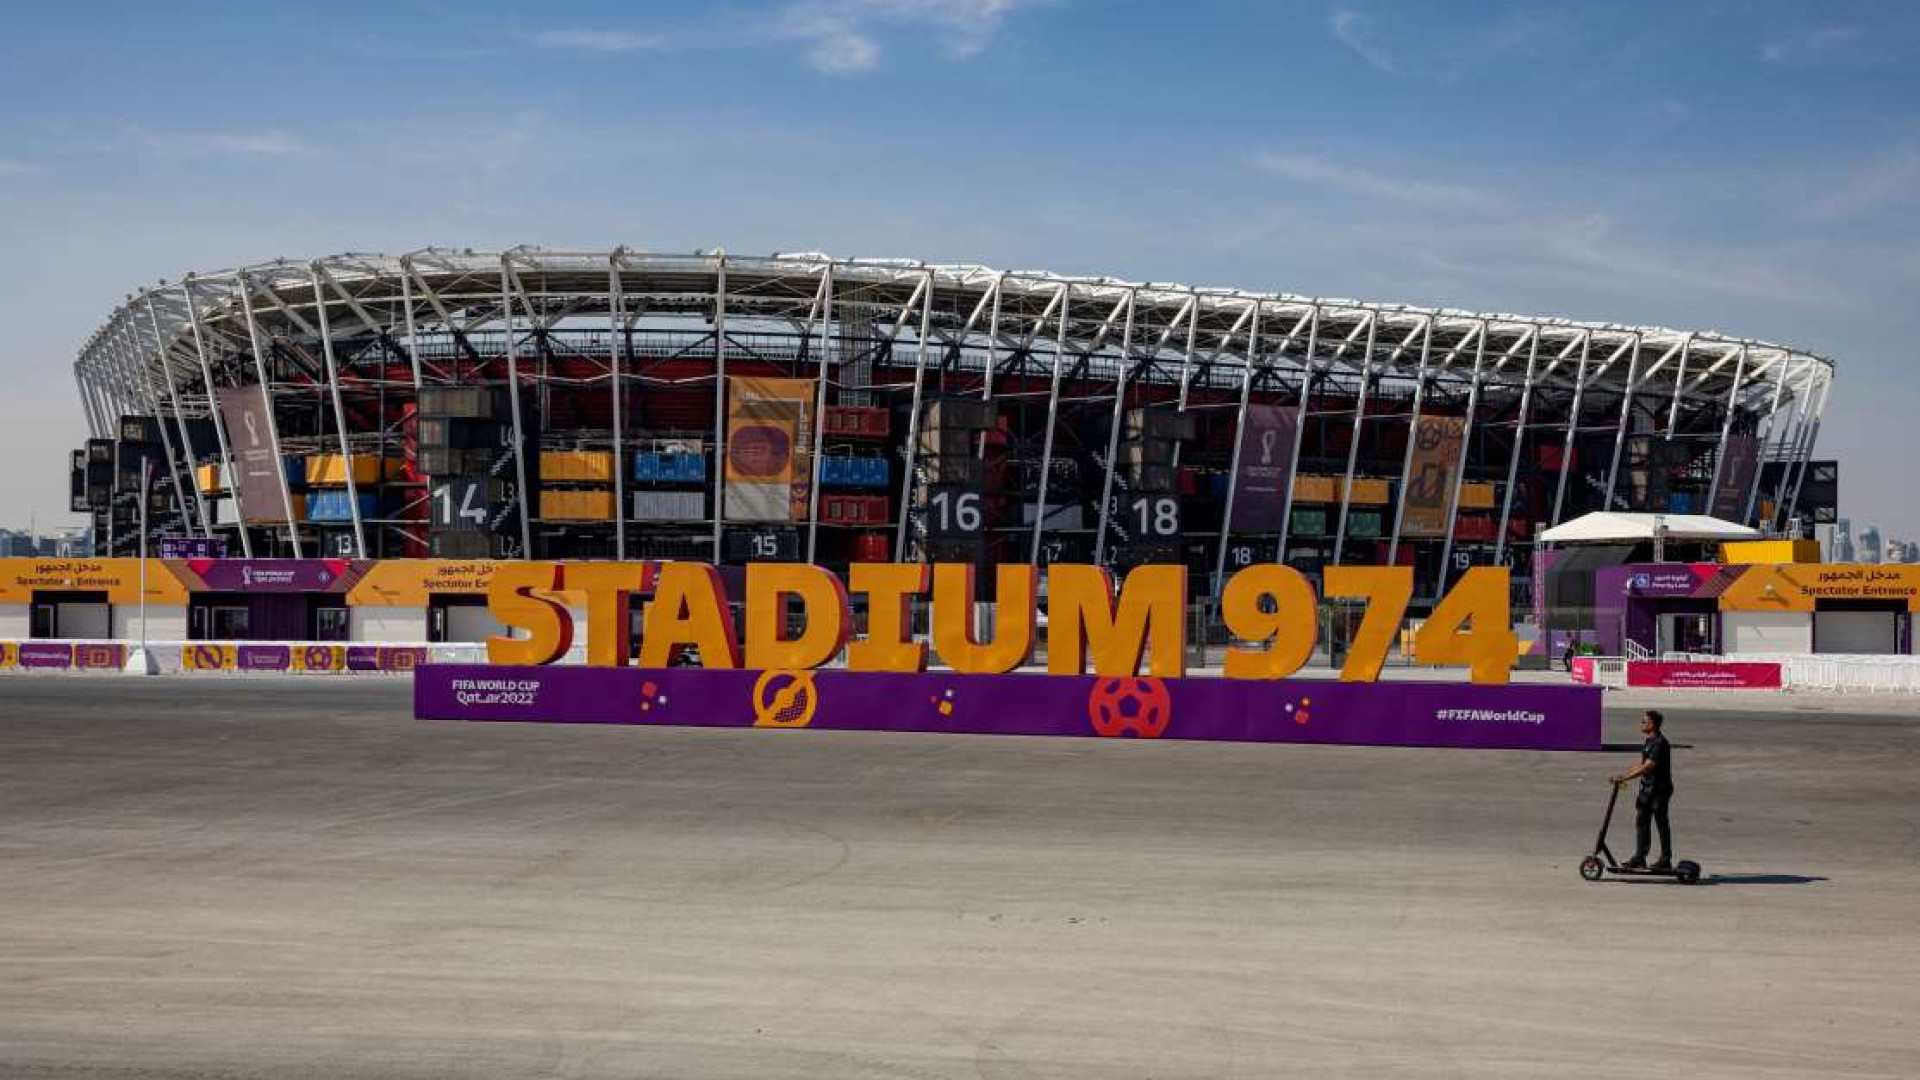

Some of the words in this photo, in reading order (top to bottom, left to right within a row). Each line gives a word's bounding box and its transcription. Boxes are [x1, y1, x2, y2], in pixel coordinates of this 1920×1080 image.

[432, 483, 486, 524] 14
[931, 492, 982, 532] 16
[1132, 498, 1179, 535] 18
[335, 535, 352, 554] 13
[752, 535, 777, 555] 15
[1232, 547, 1250, 565] 18
[1453, 552, 1469, 569] 19
[423, 579, 472, 590] Spectator
[1800, 585, 1859, 597] Spectator
[1862, 585, 1918, 596] Entrance
[487, 560, 1187, 678] STADIUM
[1222, 564, 1519, 684] 974
[452, 680, 475, 690] FIFA
[476, 680, 515, 691] WORLD
[517, 681, 540, 691] CUP
[1437, 709, 1545, 724] #FIFAWorldCup
